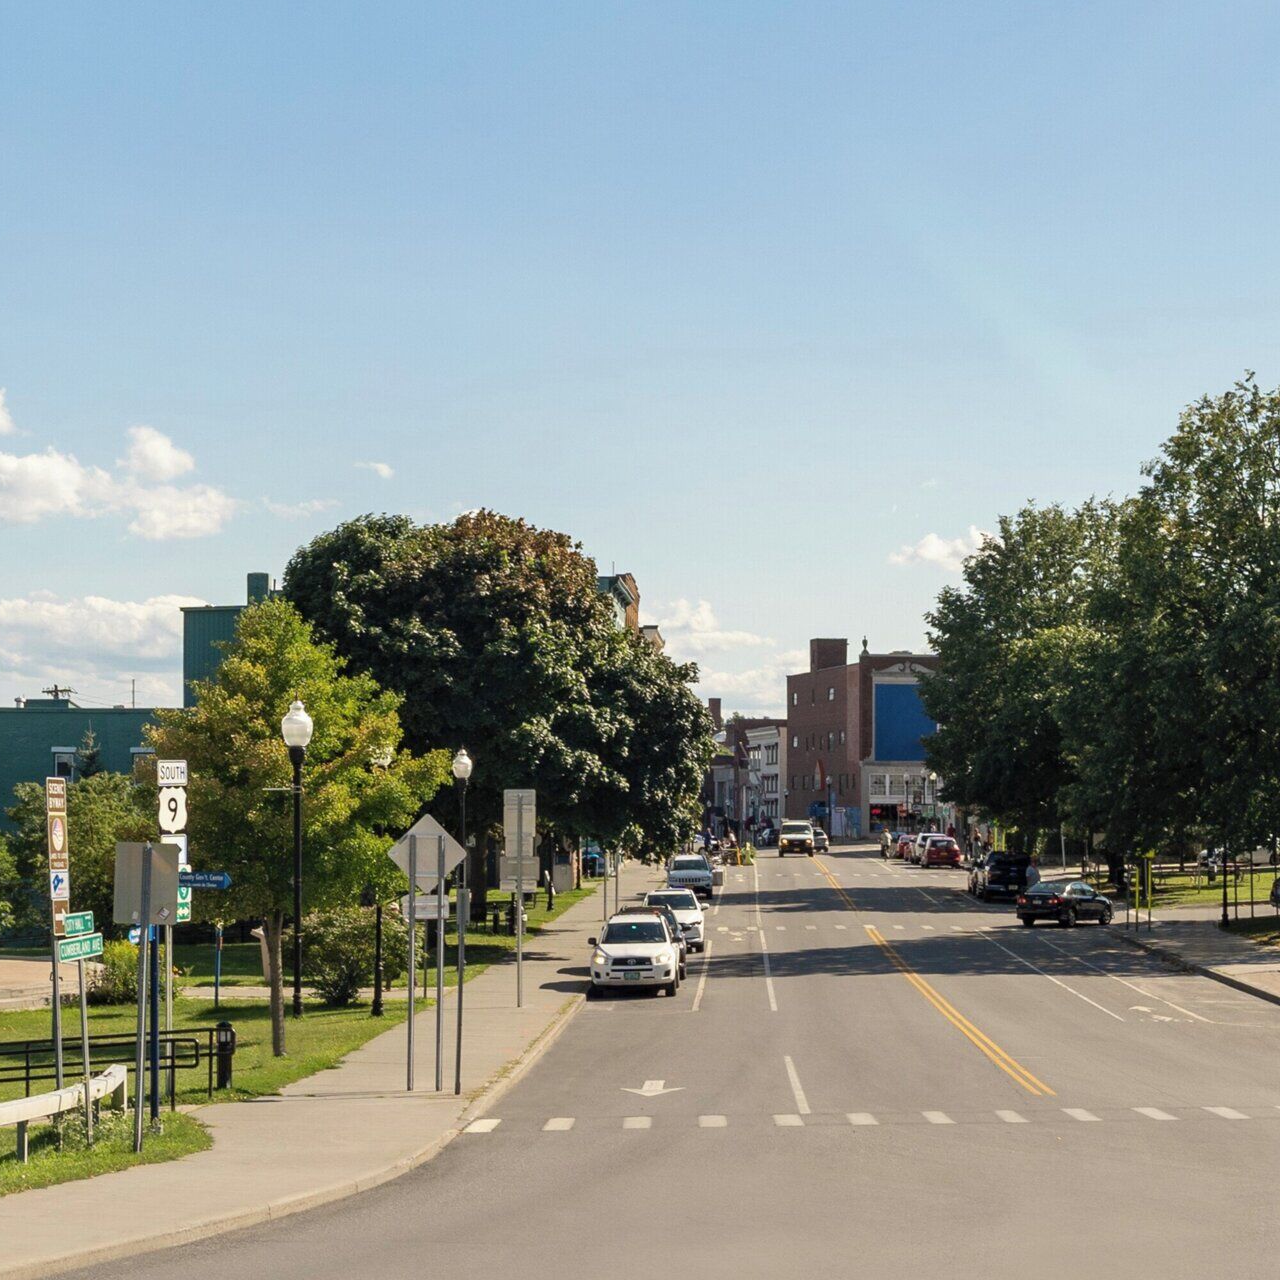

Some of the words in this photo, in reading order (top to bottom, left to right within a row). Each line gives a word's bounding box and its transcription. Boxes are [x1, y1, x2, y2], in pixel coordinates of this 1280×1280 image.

[160, 766, 186, 780] SOUTH
[49, 783, 64, 795] SCENIC
[49, 797, 64, 809] BYWAY
[167, 797, 178, 823] 9
[61, 939, 90, 957] CUMBERLAND
[92, 937, 101, 951] AVE
